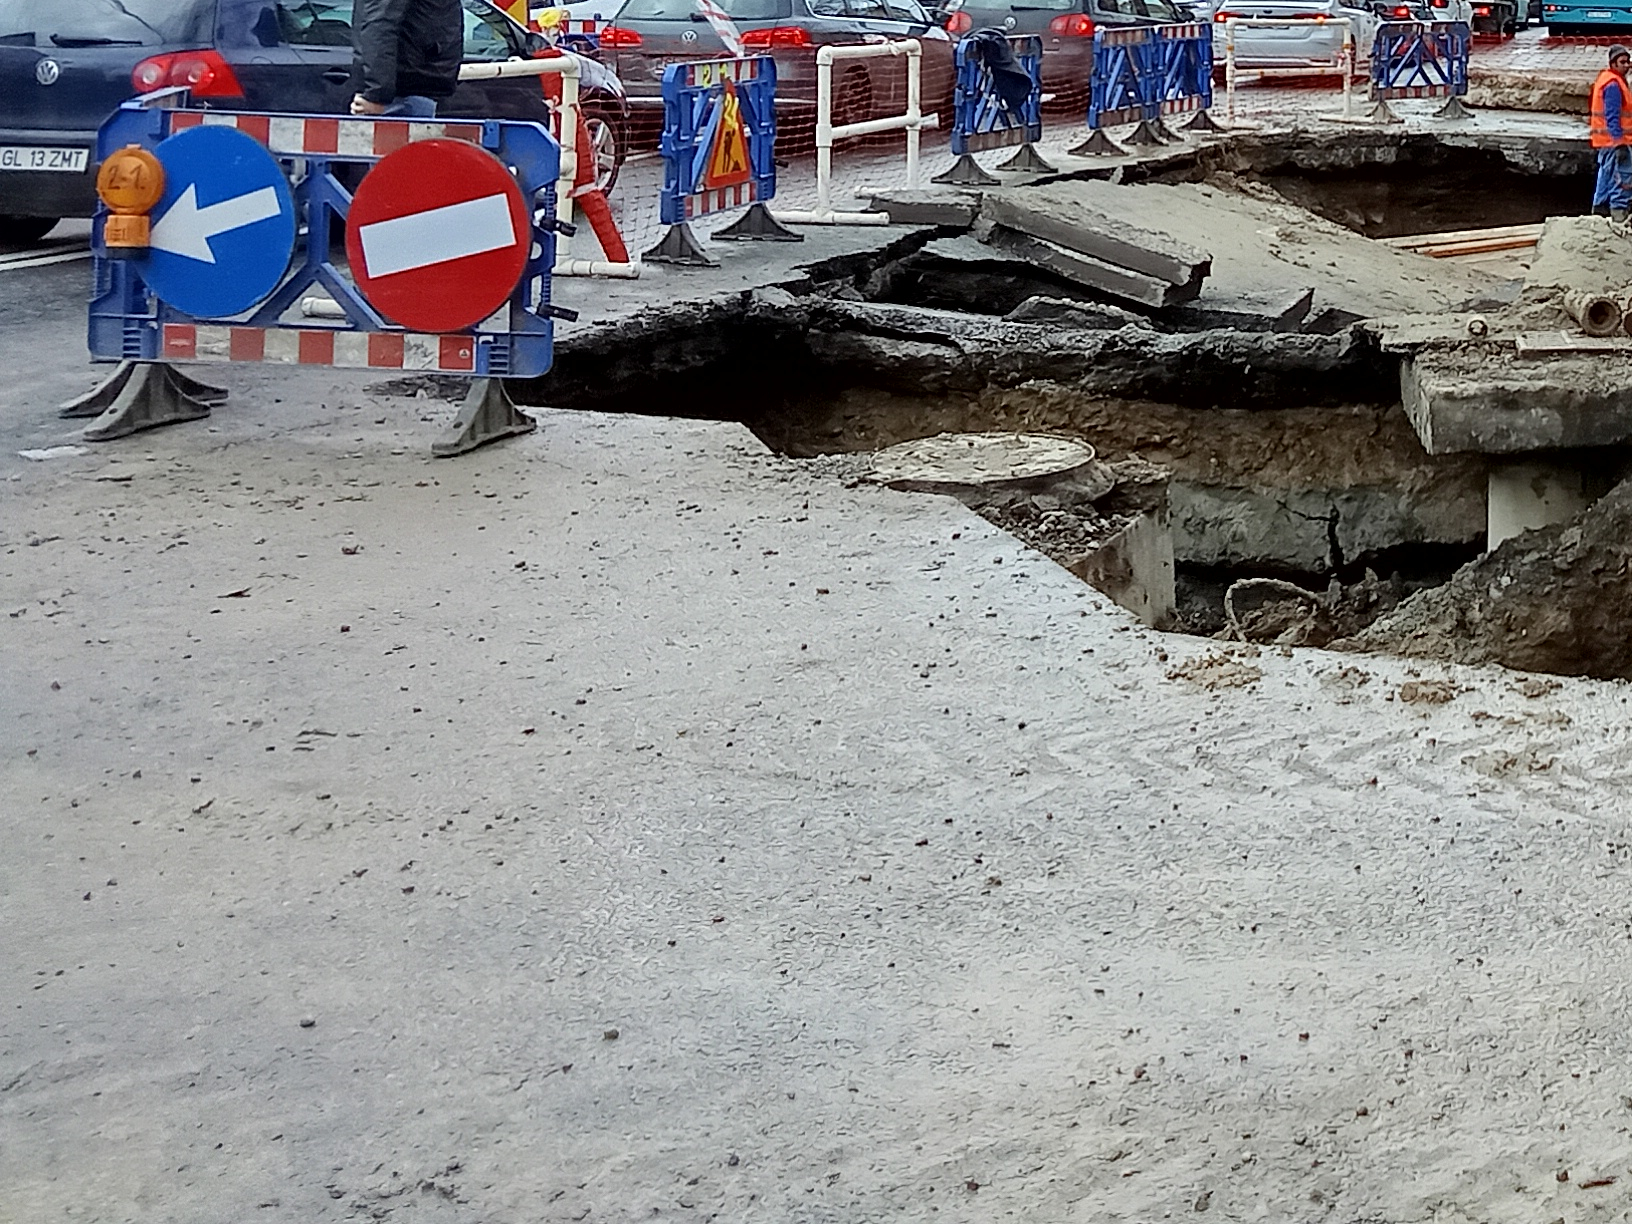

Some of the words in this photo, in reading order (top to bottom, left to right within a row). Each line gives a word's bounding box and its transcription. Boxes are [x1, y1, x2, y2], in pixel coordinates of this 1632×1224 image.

[2, 149, 22, 167] GL
[30, 150, 45, 167] 13
[49, 151, 83, 168] ZMT
